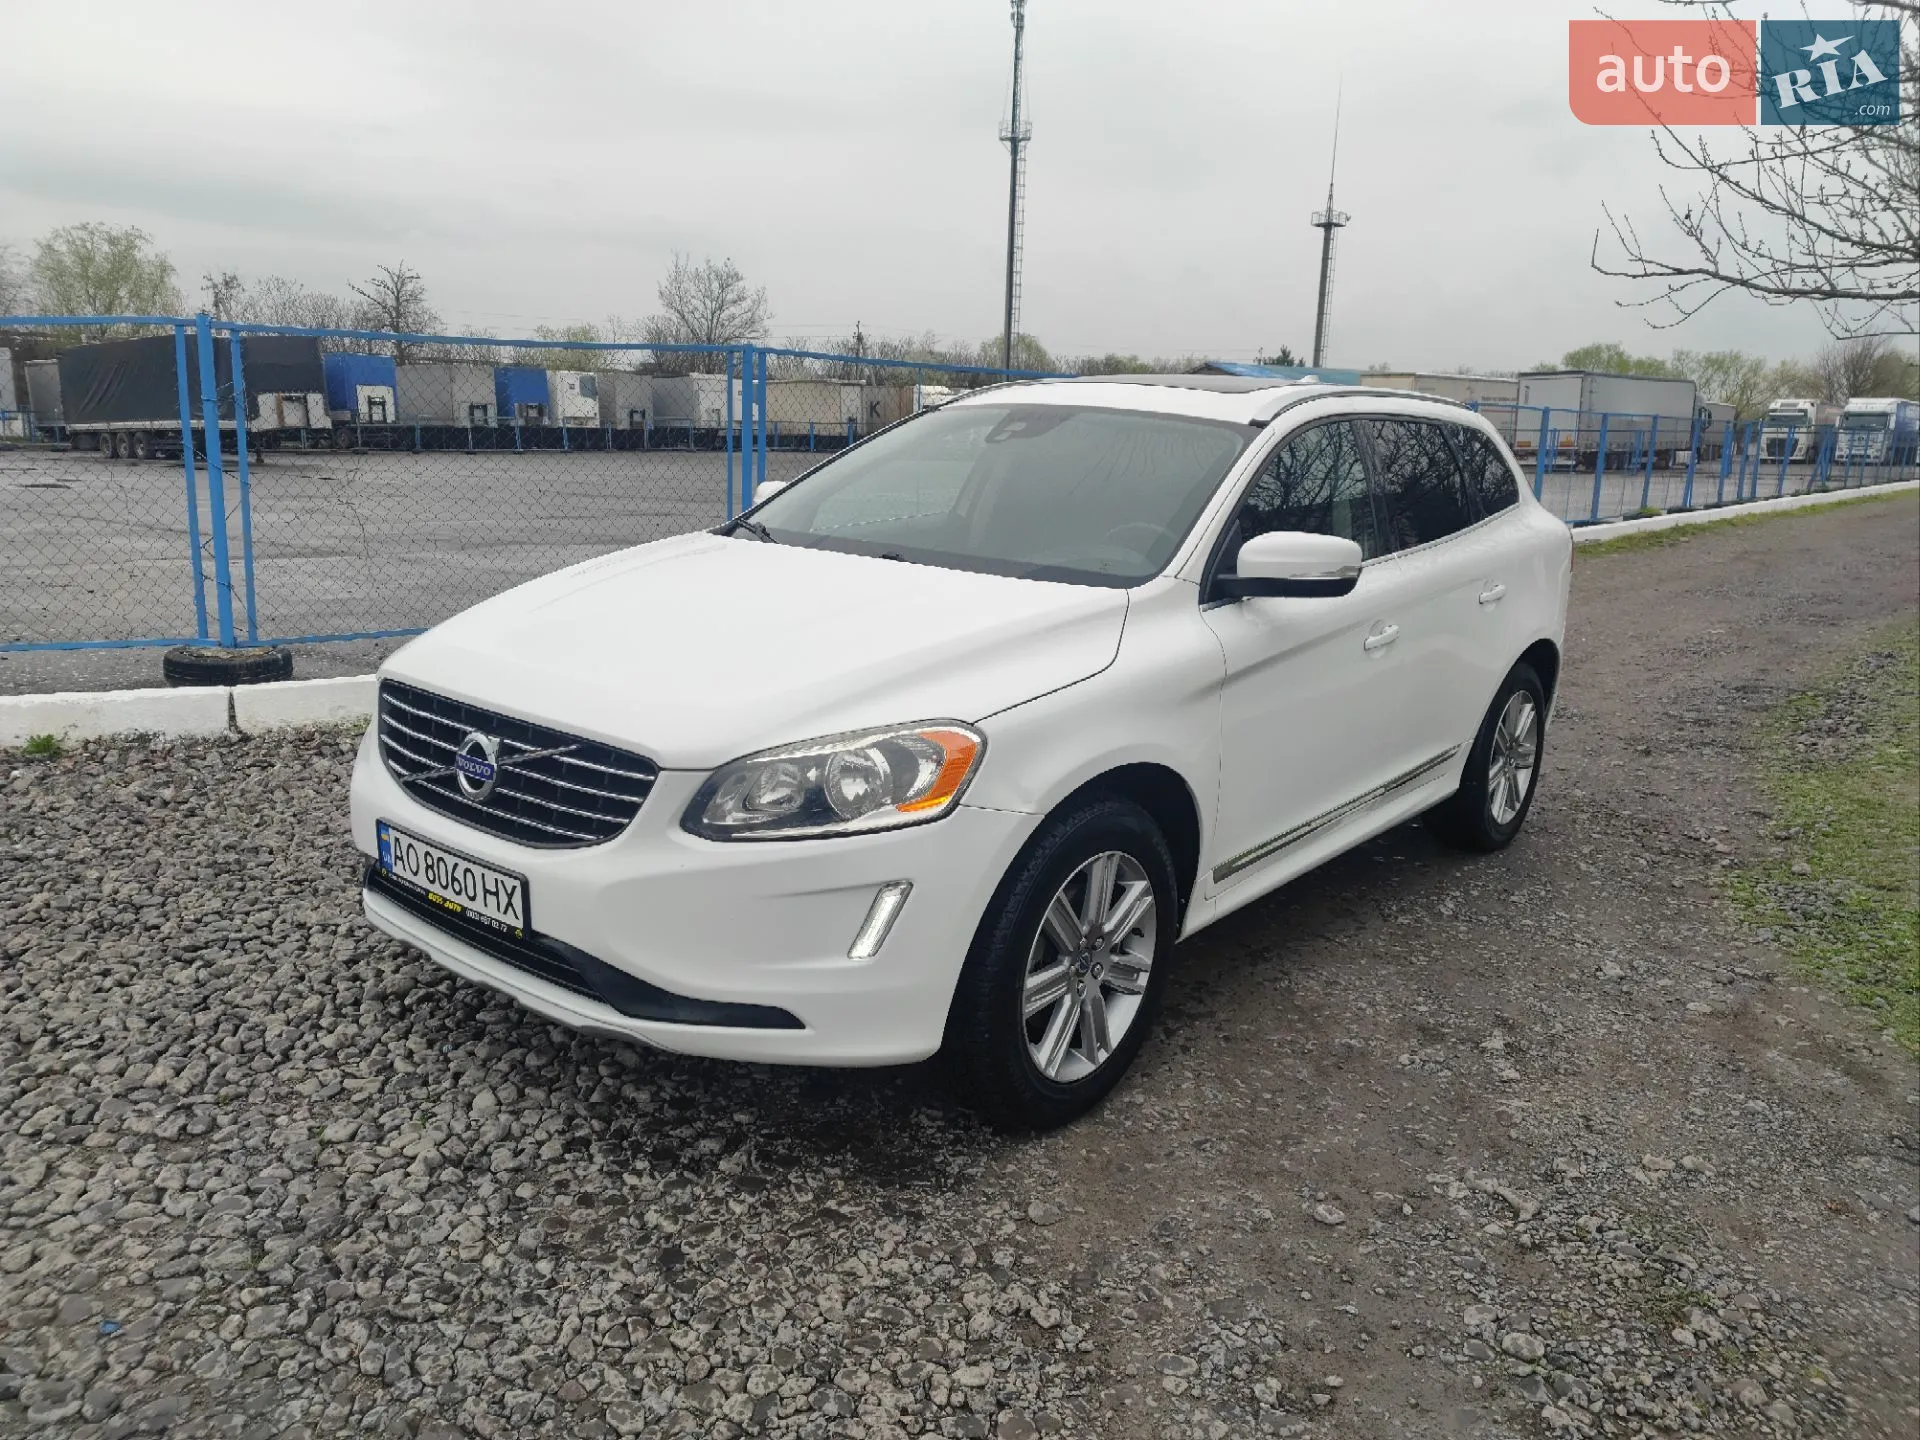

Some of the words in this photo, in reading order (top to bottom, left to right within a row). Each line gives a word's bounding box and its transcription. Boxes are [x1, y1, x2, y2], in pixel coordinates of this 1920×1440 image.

[458, 758, 491, 776] VOLVO
[394, 835, 420, 877] AO
[424, 850, 477, 902] 8060
[481, 872, 520, 920] HX
